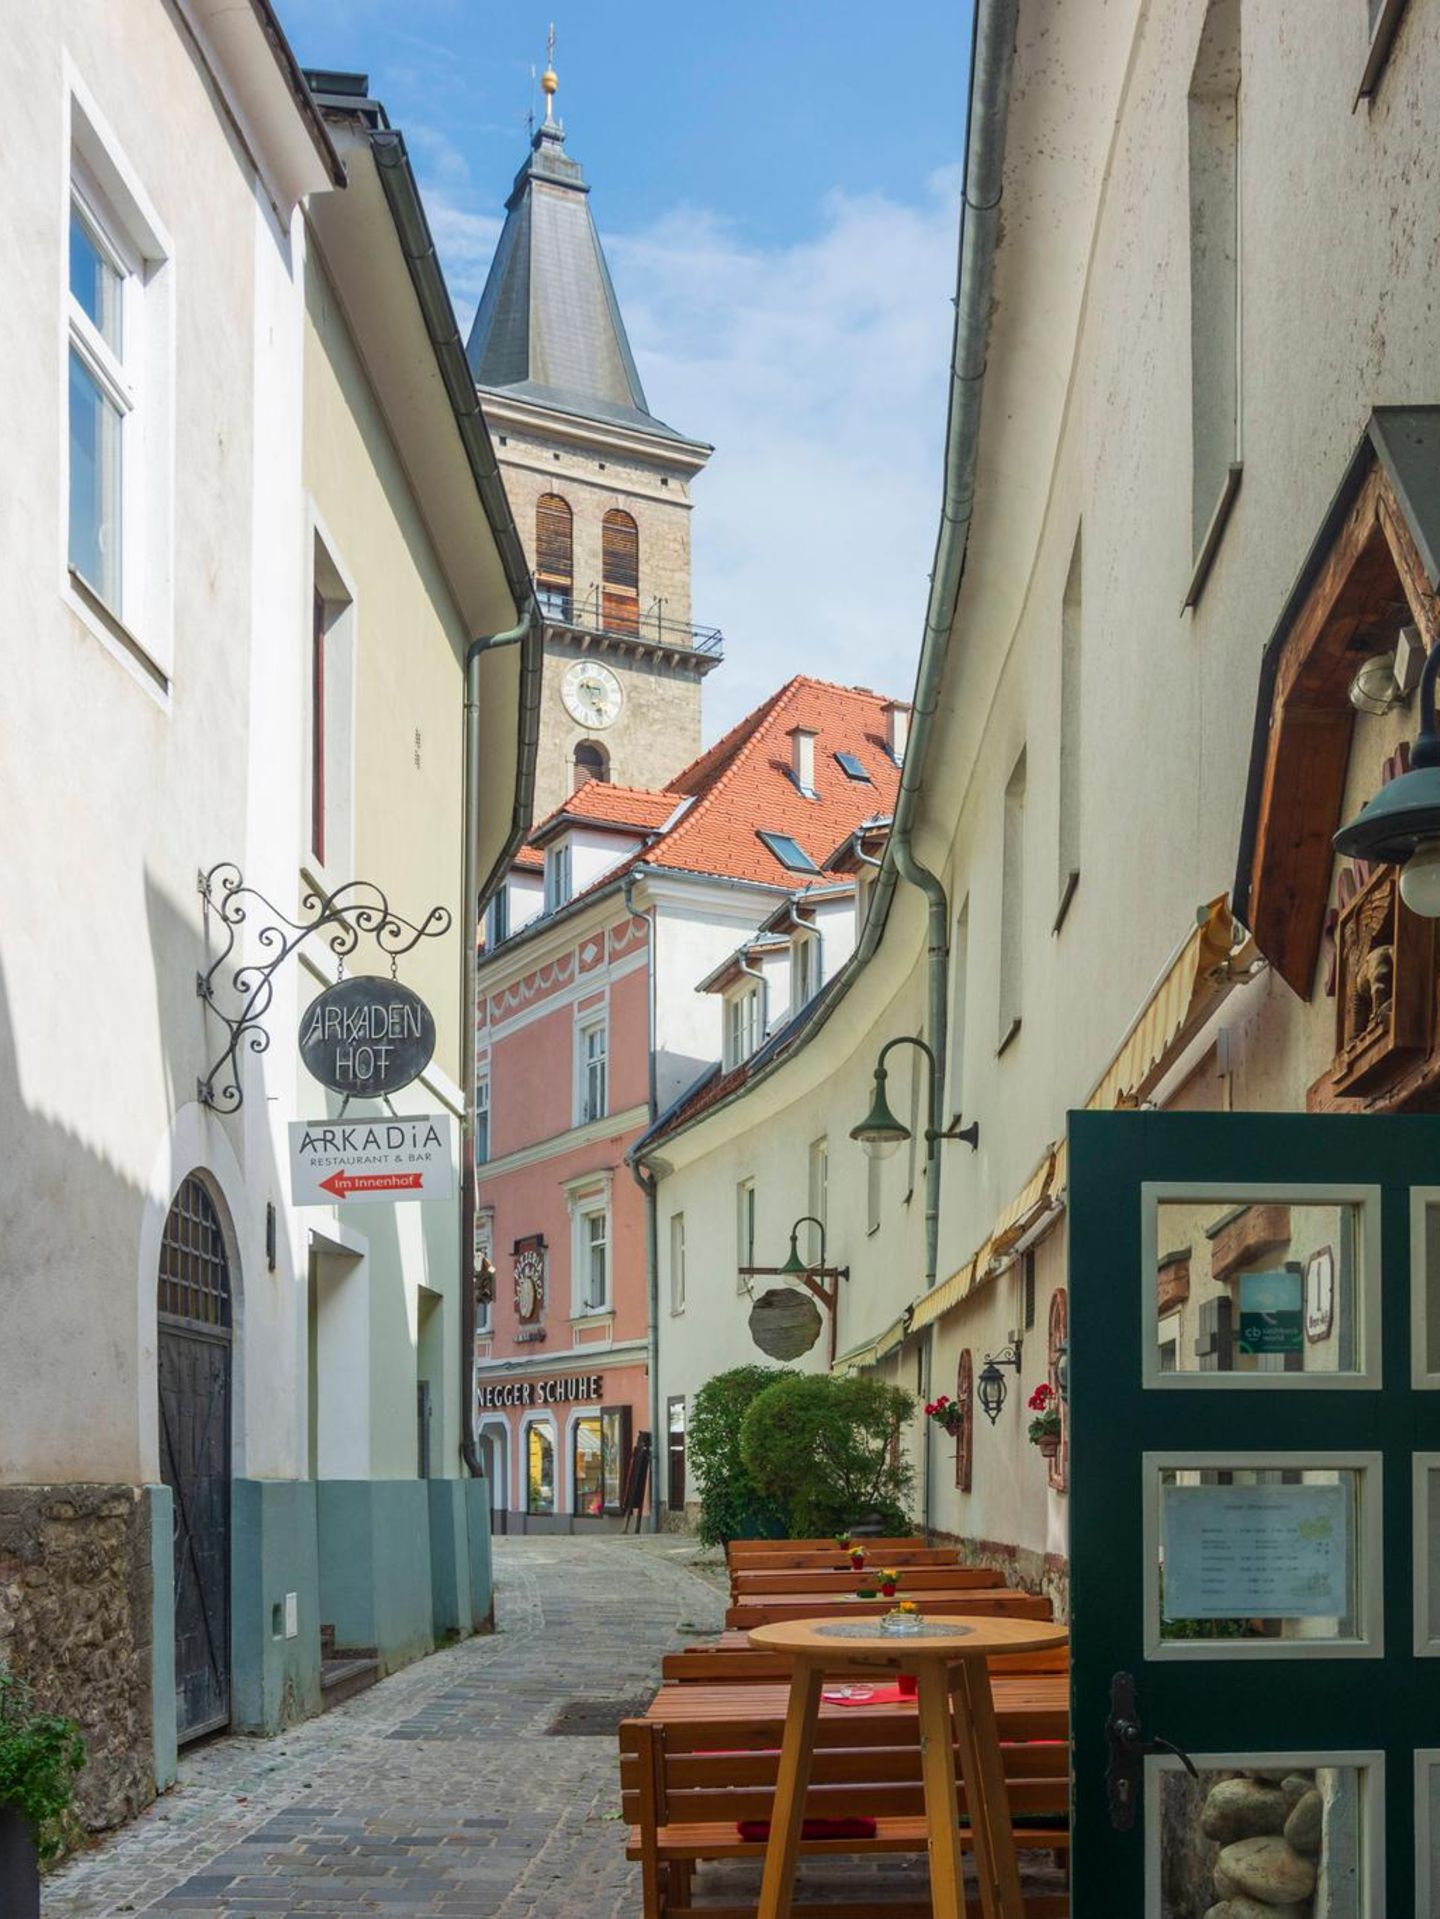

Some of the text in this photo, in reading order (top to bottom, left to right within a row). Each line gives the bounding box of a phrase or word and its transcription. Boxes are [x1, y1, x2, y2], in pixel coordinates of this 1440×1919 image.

[302, 1003, 421, 1045] ARKADEN
[309, 1152, 433, 1168] RESTAURANT & BAR
[334, 1175, 415, 1189] Im Innenhof
[537, 1375, 599, 1404] SCHUHE
